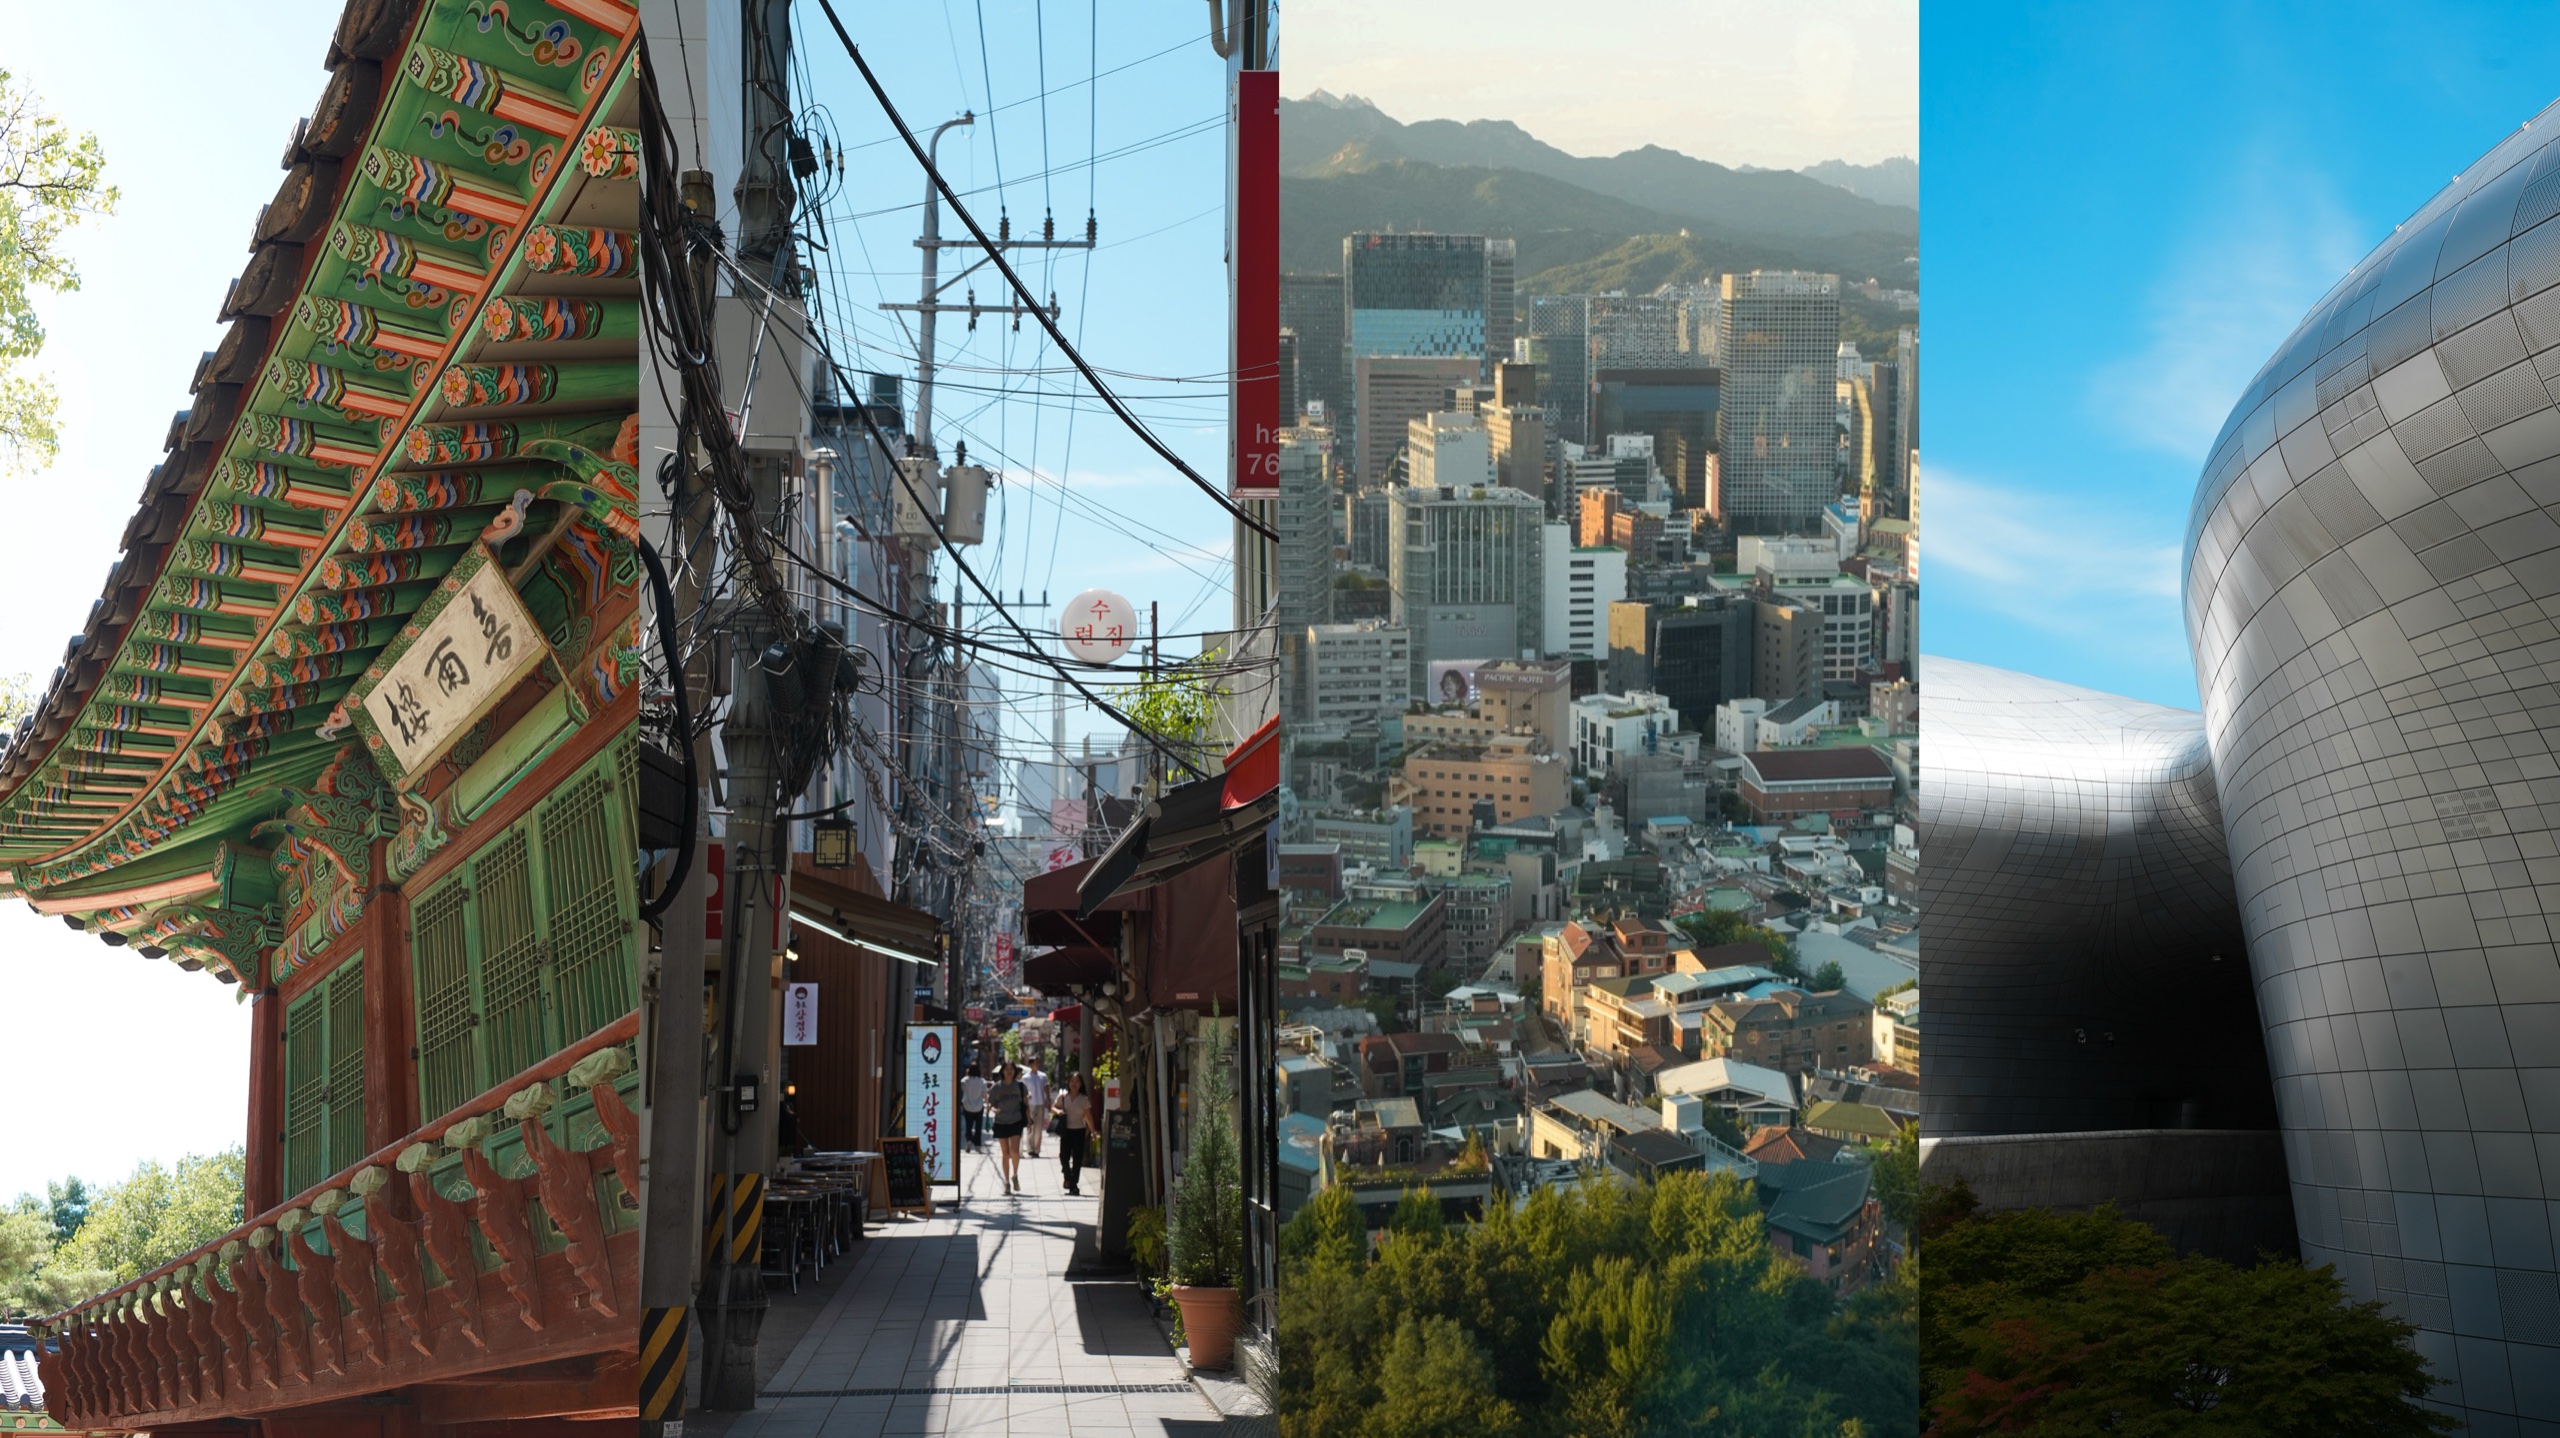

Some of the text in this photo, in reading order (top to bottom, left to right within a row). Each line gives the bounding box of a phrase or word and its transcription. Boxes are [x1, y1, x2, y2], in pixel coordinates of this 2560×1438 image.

[1247, 452, 1279, 476] 76
[1484, 673, 1515, 682] PACIFIC
[1518, 674, 1544, 684] HOTEL
[921, 1072, 940, 1089] 종로
[922, 1091, 941, 1170] 삼겹살
